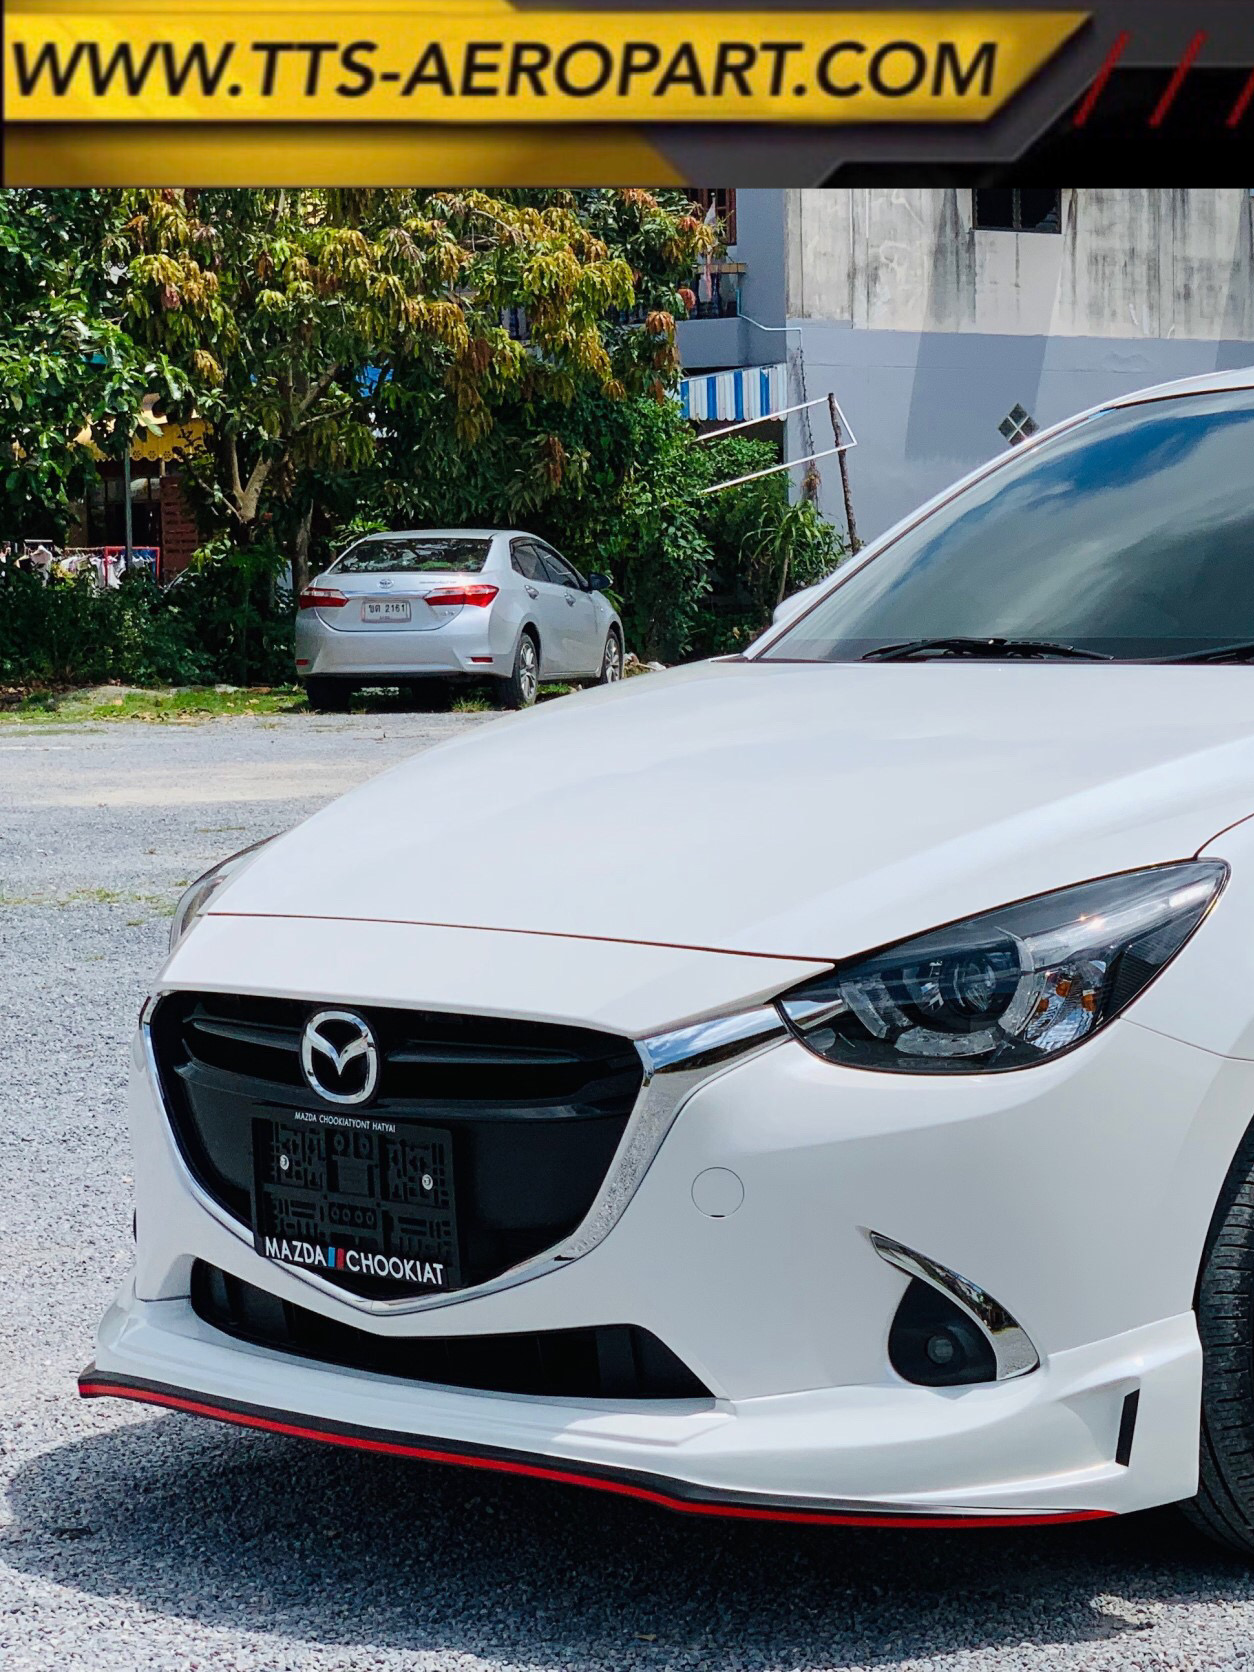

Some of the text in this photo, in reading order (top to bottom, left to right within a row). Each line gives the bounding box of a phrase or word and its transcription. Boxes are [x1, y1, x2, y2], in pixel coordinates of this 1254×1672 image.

[294, 1111, 317, 1122] MAZDA
[372, 1122, 396, 1133] HATYAI
[265, 1236, 443, 1285] MAZDA CHOOKIAT
